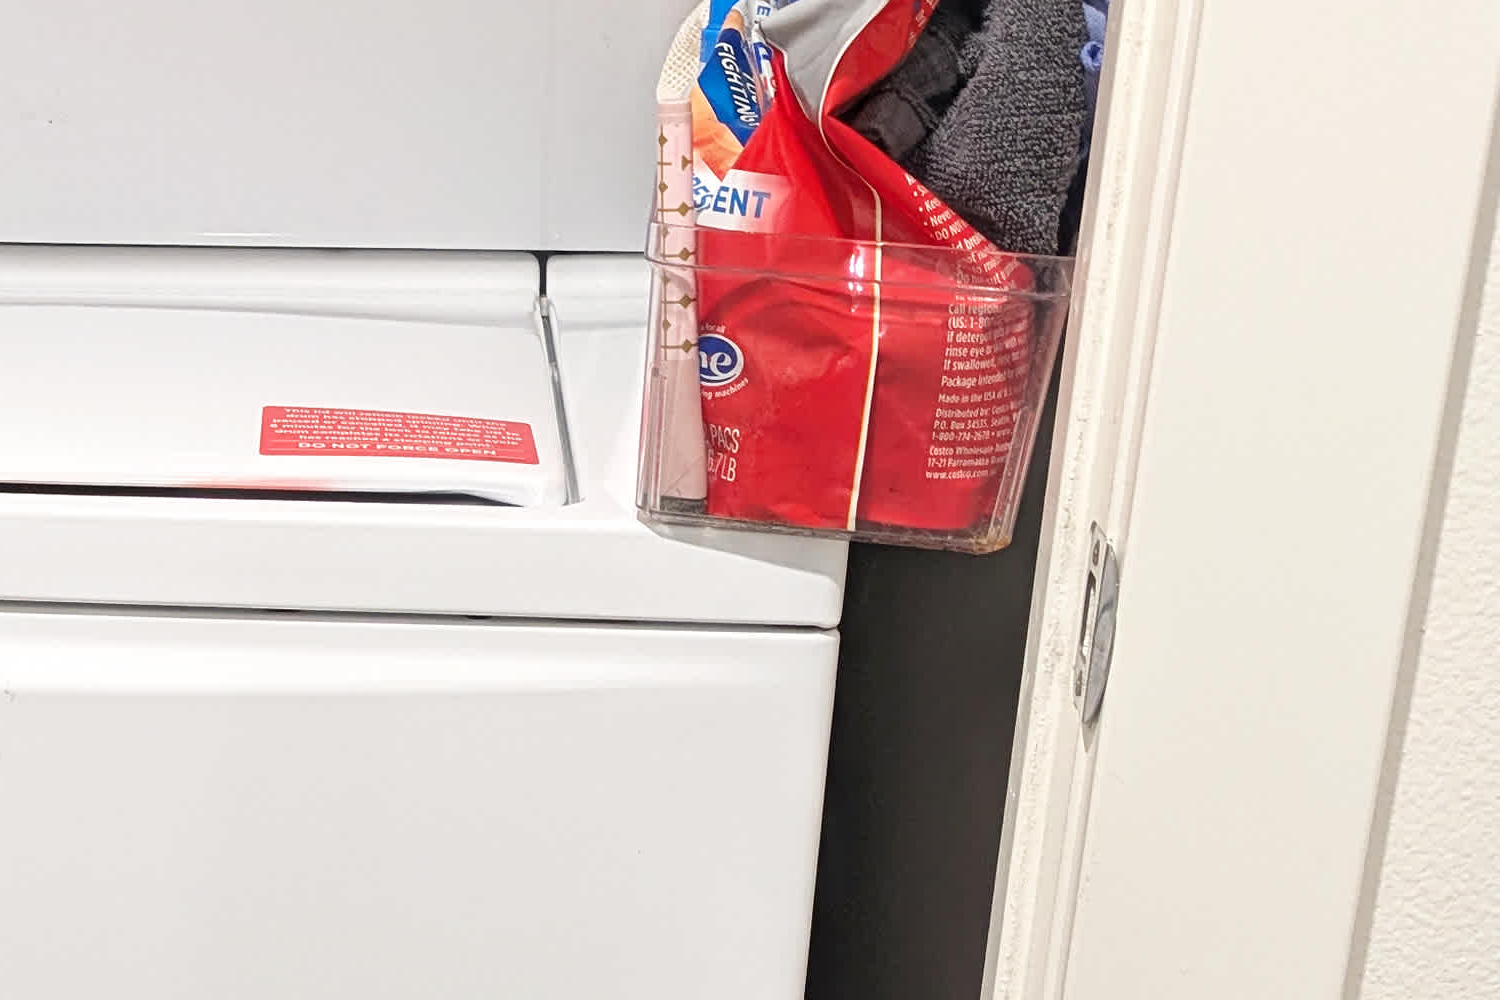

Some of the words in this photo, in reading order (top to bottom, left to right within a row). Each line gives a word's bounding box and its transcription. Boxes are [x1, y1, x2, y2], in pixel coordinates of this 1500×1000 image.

[945, 346, 968, 358] rinse
[970, 347, 985, 359] eye
[941, 375, 977, 389] Package
[938, 393, 960, 404] Made
[936, 407, 979, 418] Distributed
[710, 423, 740, 454] PACS
[375, 444, 438, 452] FORCE
[930, 445, 955, 456] Costco
